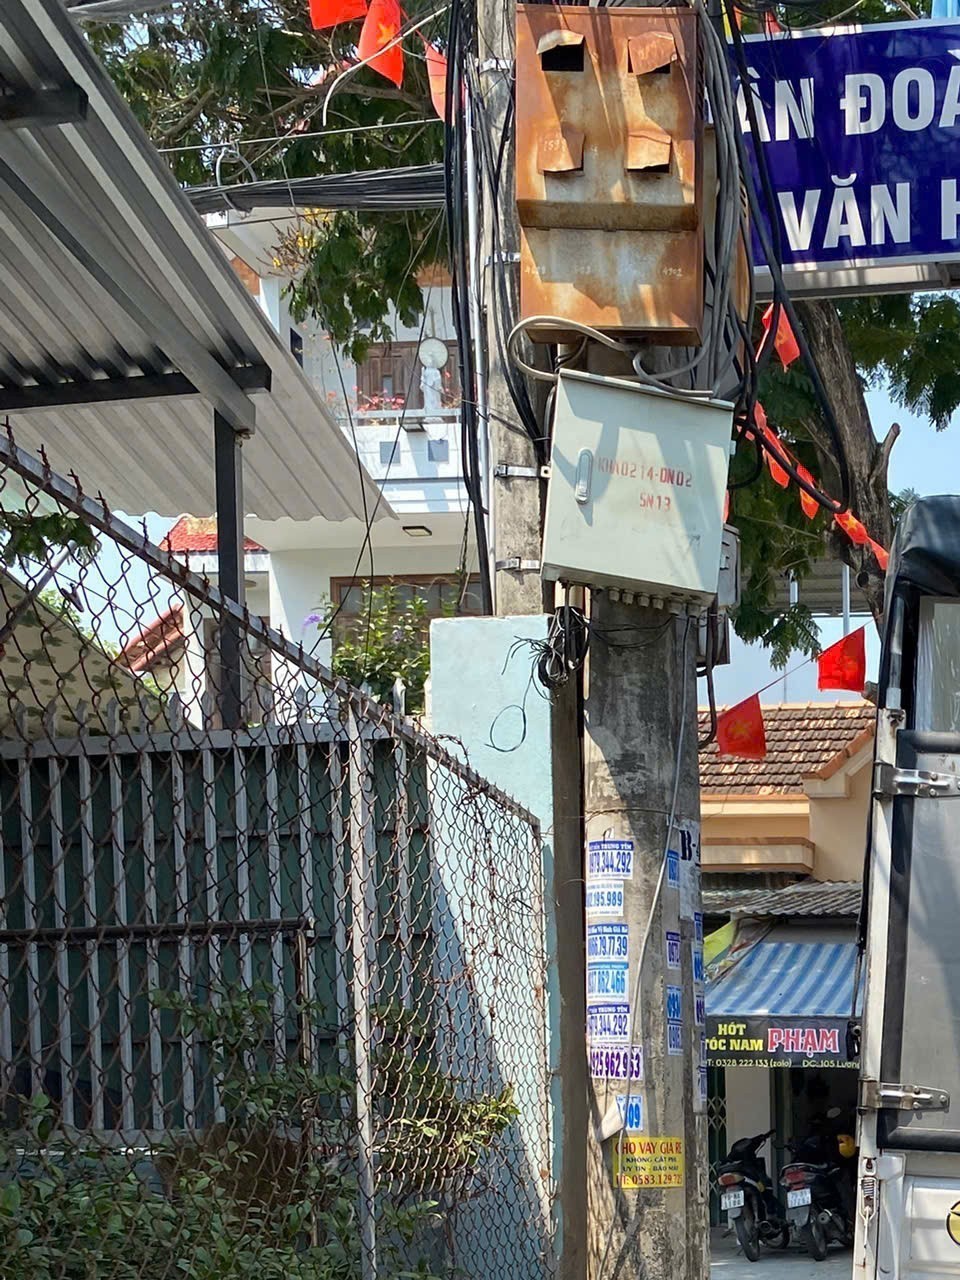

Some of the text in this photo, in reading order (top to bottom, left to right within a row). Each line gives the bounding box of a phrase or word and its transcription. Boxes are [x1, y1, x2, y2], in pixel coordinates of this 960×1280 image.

[778, 173, 910, 252] VĂN
[729, 1038, 764, 1051] NAM
[767, 1028, 840, 1058] PHẠM
[739, 1059, 755, 1067] 222
